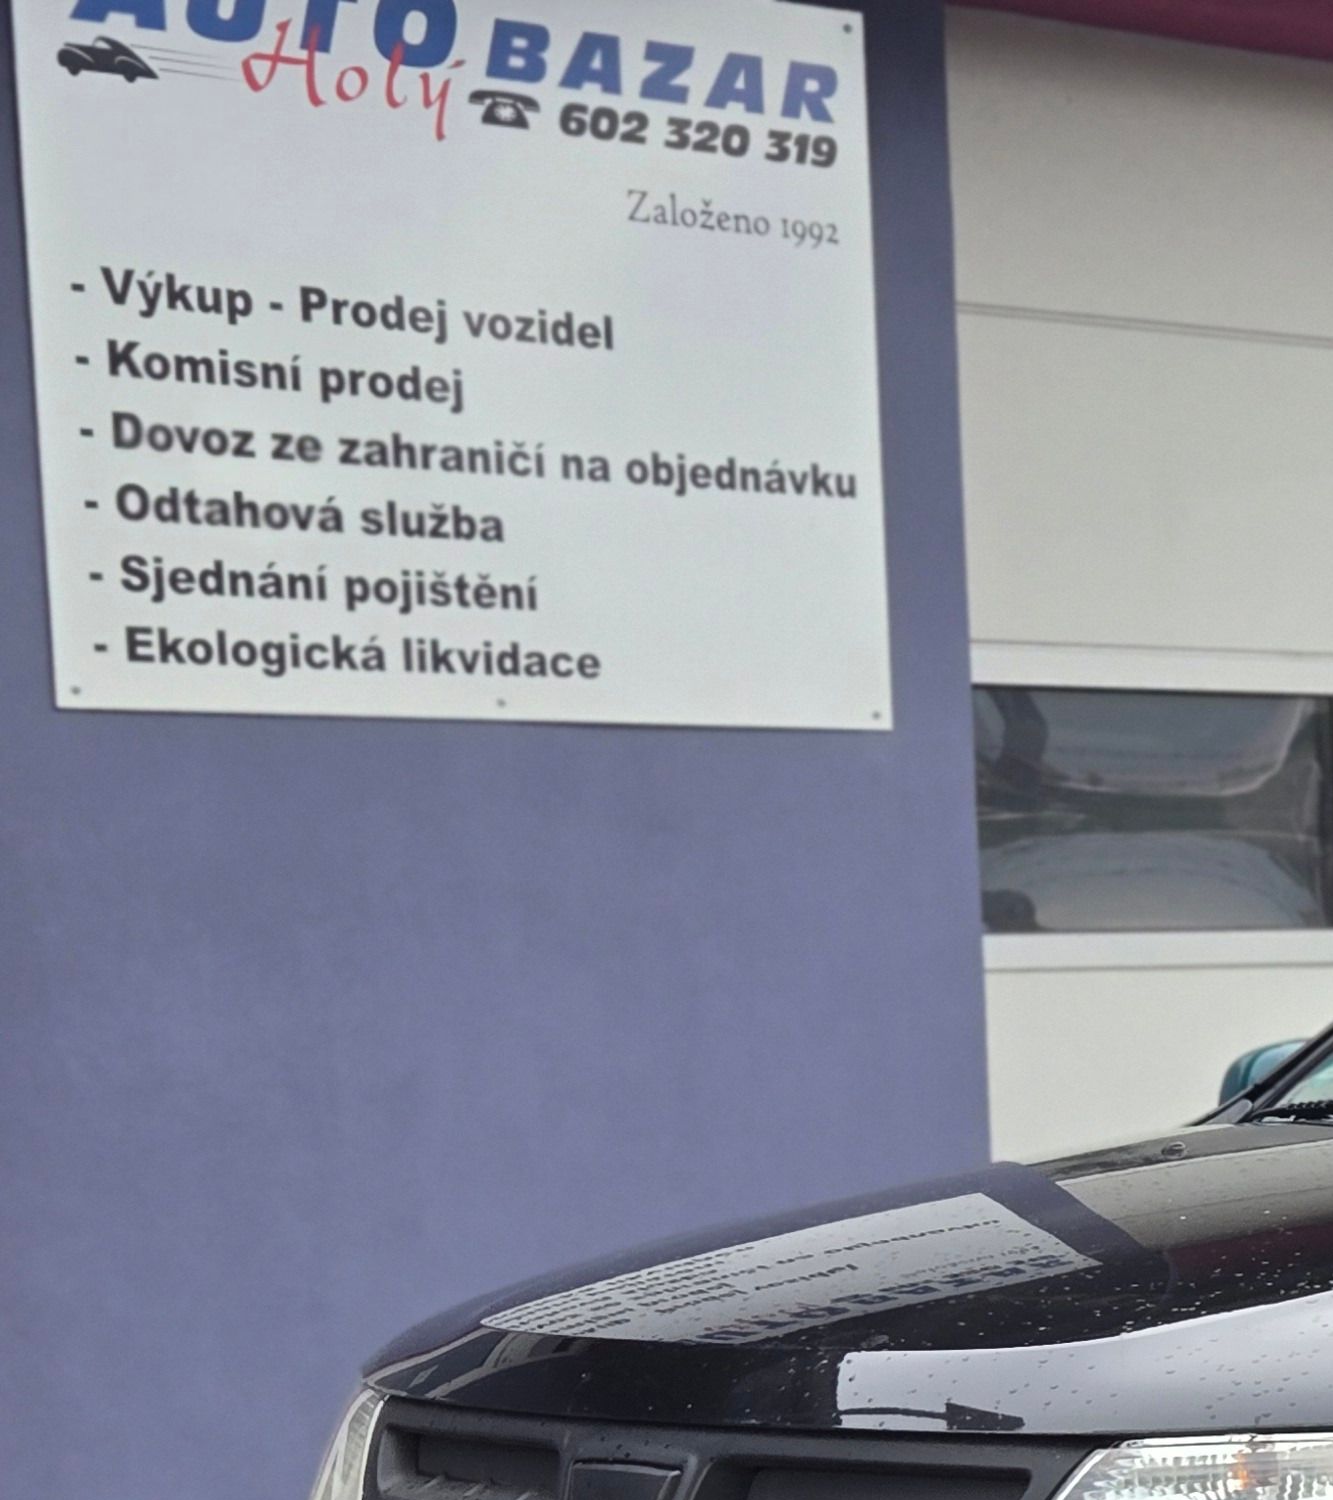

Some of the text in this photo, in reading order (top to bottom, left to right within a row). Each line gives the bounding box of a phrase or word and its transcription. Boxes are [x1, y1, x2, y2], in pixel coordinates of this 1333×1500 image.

[242, 19, 467, 141] Holý
[485, 18, 839, 124] BAZAR
[559, 103, 838, 169] 602 320 319
[627, 189, 840, 249] Založeno 1992
[99, 266, 253, 326] Výkup
[299, 285, 448, 345] Prodej
[462, 308, 614, 351] vozidel
[106, 339, 302, 392] Komisní
[319, 366, 464, 415] prodej
[111, 411, 257, 459] Dovoz
[270, 432, 323, 464] ze
[338, 431, 545, 479] zahraničí
[561, 453, 611, 483] na
[625, 451, 857, 499] objednávku
[115, 483, 345, 534] Odtahová
[360, 499, 505, 543] služba
[120, 555, 328, 604] Sjednání
[344, 569, 538, 616] pojištění
[124, 626, 387, 678] Ekologická
[402, 637, 601, 679] likvidace
